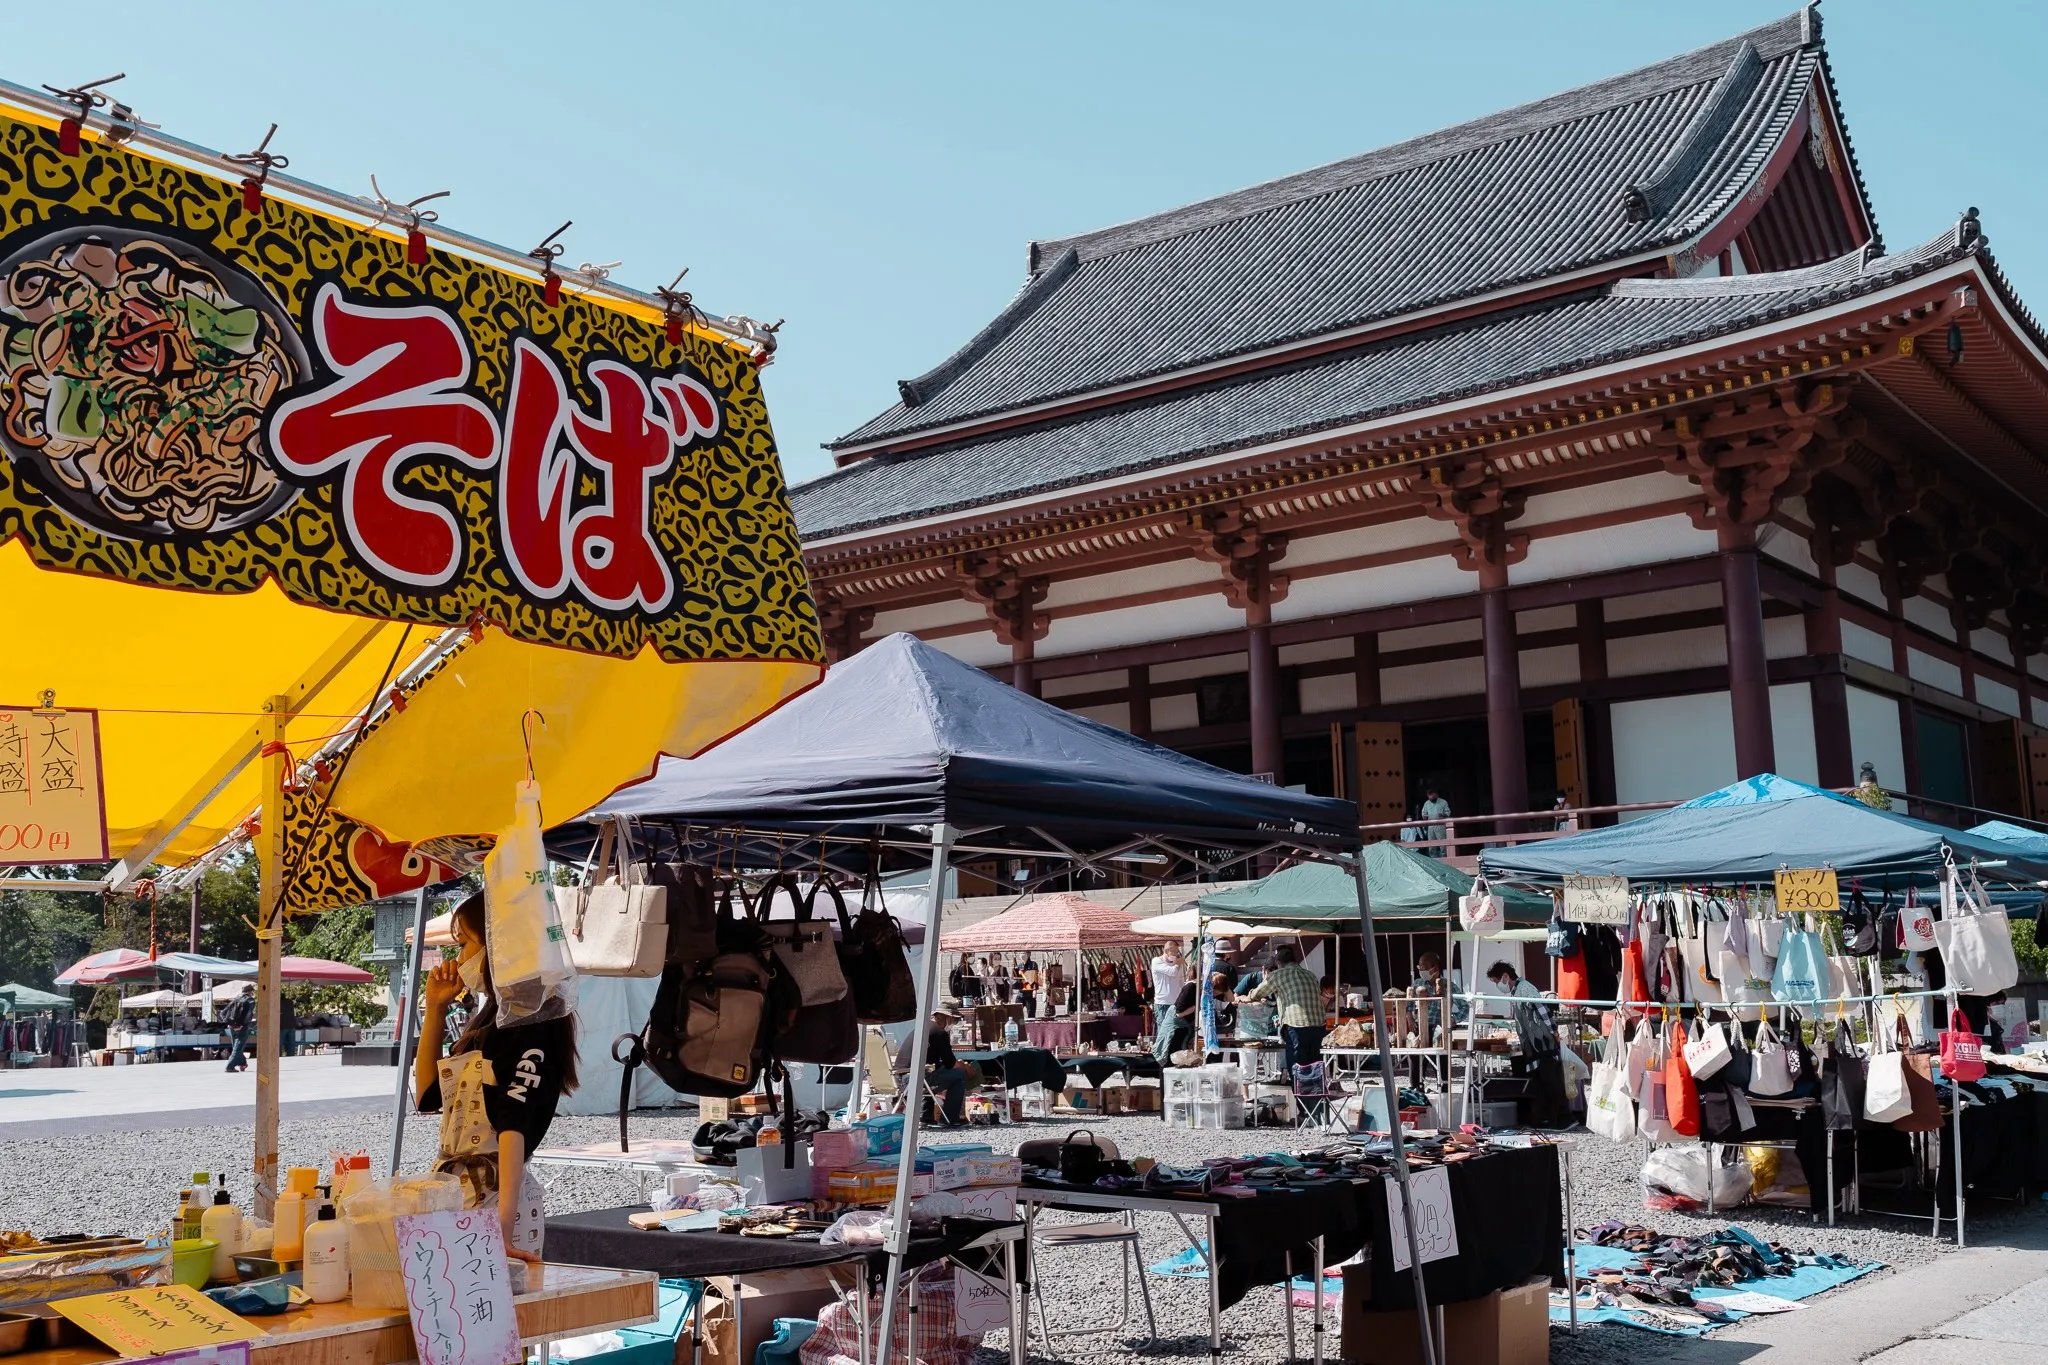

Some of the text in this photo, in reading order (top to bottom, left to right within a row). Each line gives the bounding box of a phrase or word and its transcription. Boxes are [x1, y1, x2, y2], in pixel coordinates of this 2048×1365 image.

[272, 283, 720, 614] そば
[41, 721, 84, 793] 大盛
[1780, 871, 1826, 886] バック
[1785, 888, 1834, 908] ¥300
[454, 1232, 493, 1325] アマニ油
